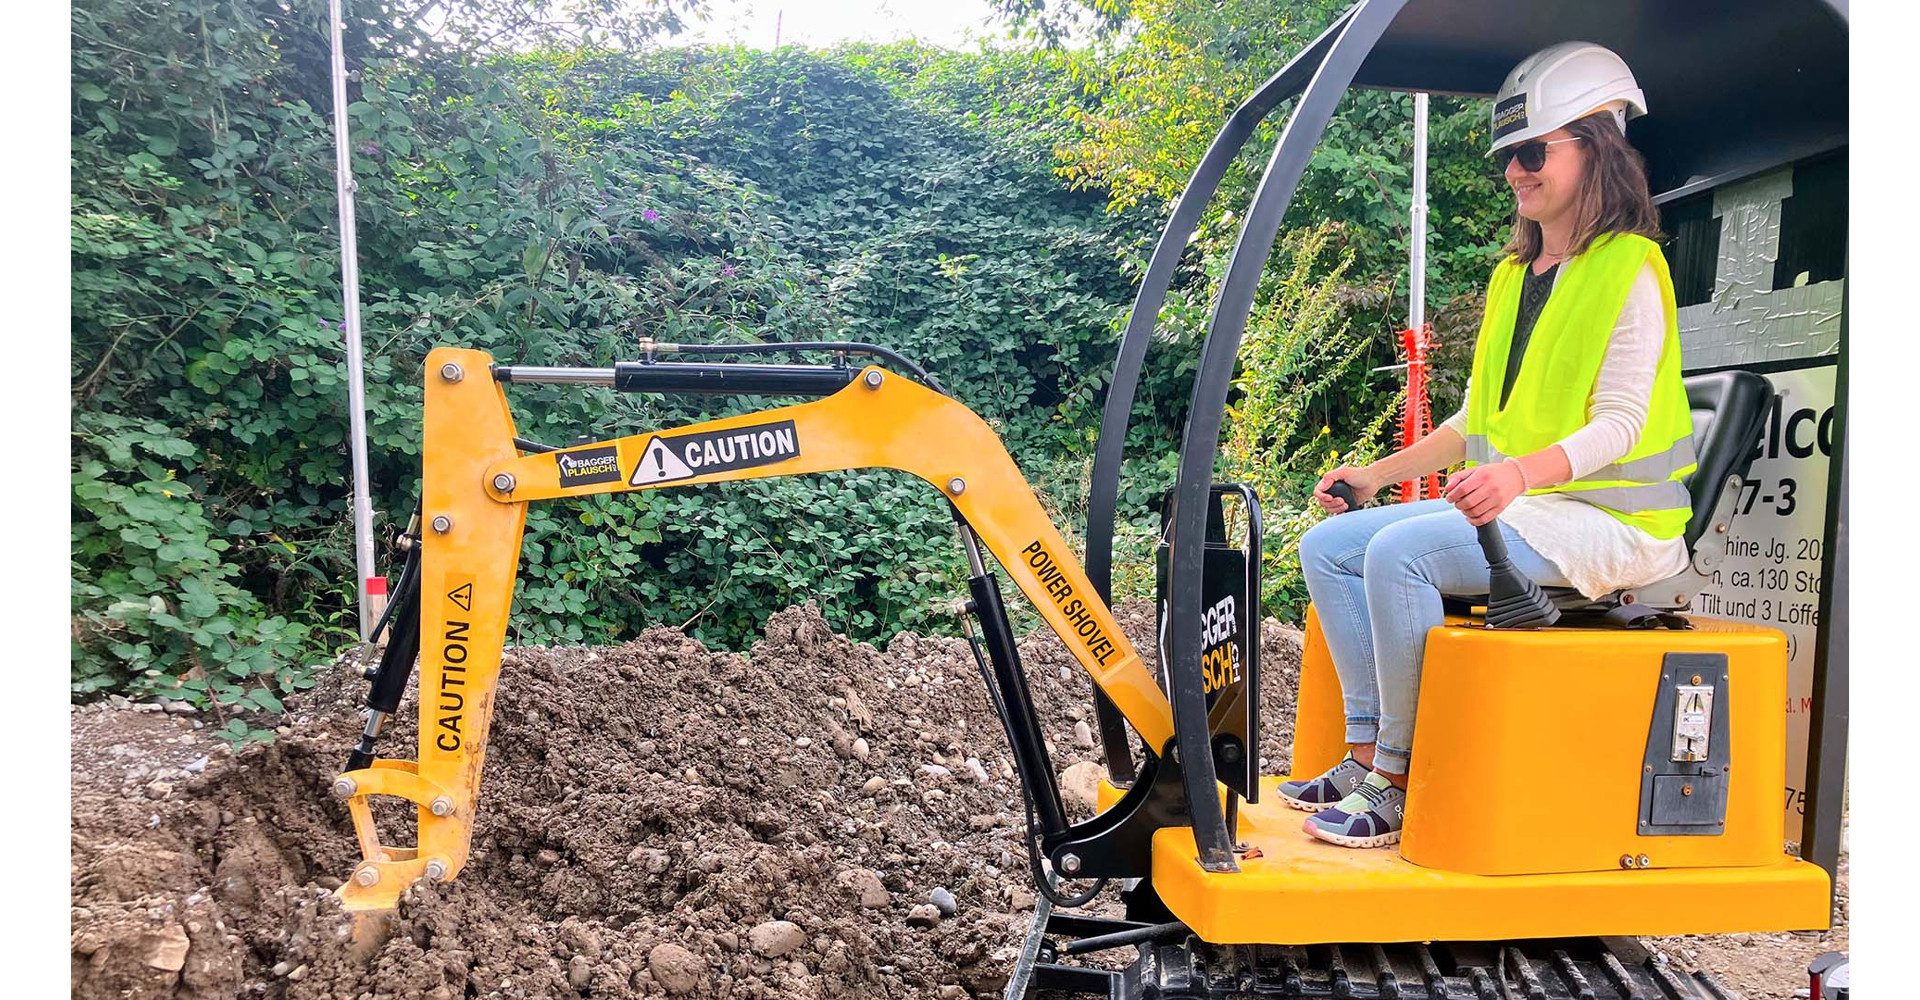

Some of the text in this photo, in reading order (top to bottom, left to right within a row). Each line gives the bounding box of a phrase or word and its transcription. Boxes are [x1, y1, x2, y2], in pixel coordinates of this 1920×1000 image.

[577, 456, 616, 468] BAGGER
[685, 428, 796, 468] CAUTION
[567, 464, 613, 478] PLAUSCH
[1733, 479, 1797, 516] 7-3
[1765, 538, 1790, 564] Jg.
[1797, 539, 1823, 561] 20
[1022, 540, 1116, 667] POWER SHOVEL
[1700, 593, 1721, 615] Tilt
[1726, 599, 1756, 618] und
[1762, 600, 1772, 620] 3
[437, 620, 470, 752] CAUTION
